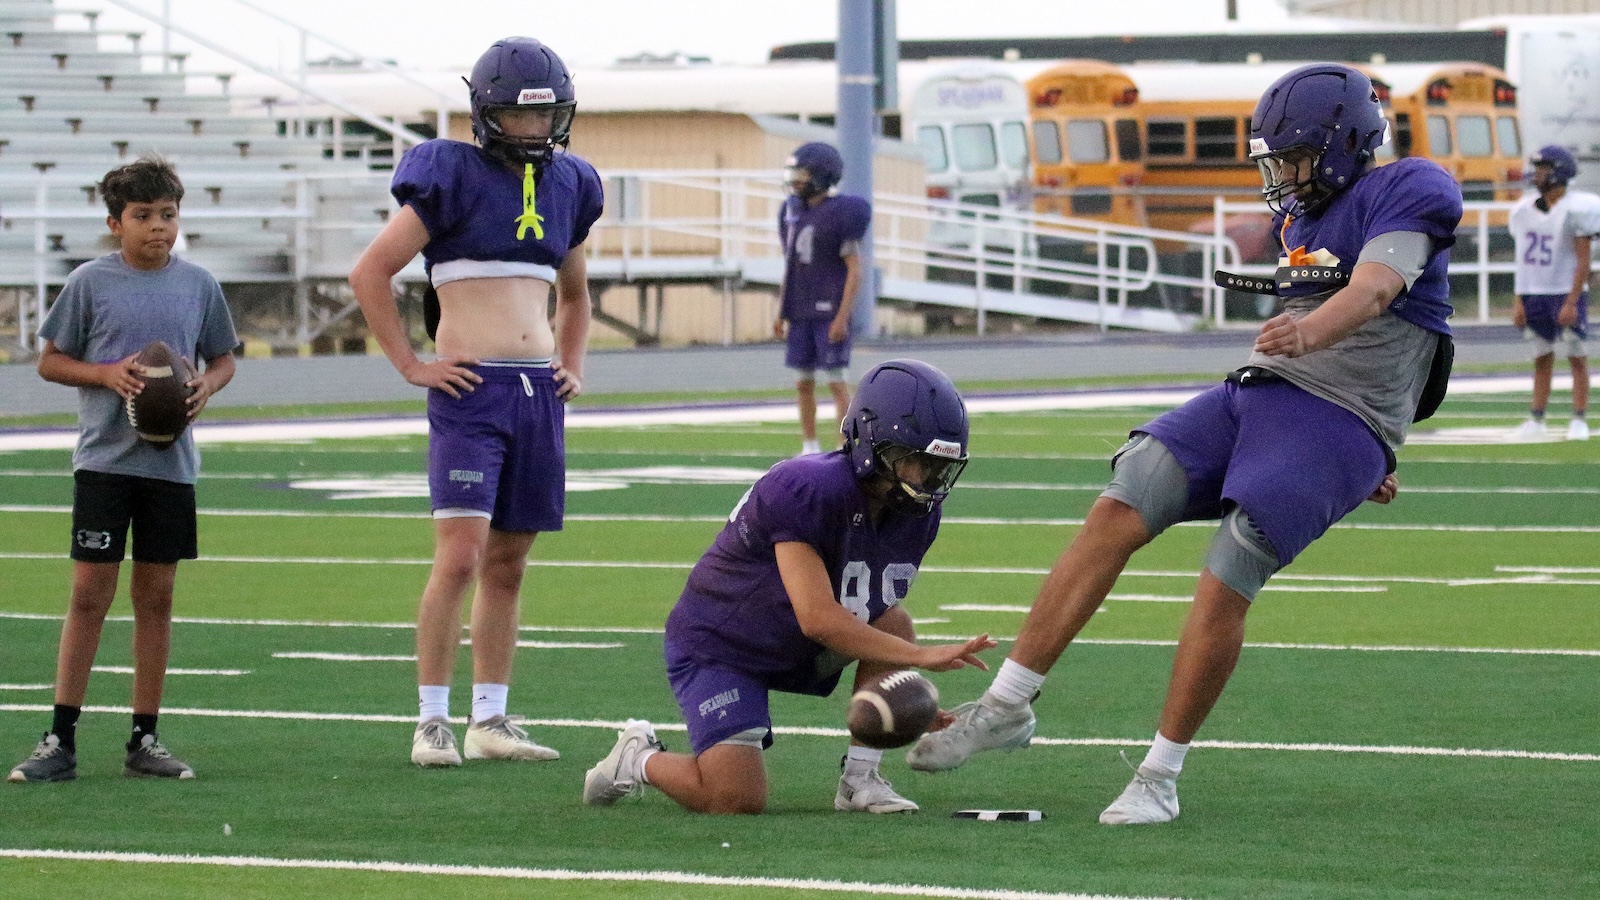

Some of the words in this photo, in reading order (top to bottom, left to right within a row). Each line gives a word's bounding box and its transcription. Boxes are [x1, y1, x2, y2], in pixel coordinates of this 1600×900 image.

[1524, 231, 1552, 266] 25
[933, 444, 960, 455] Riddell
[699, 688, 740, 717] SPEARMAN
